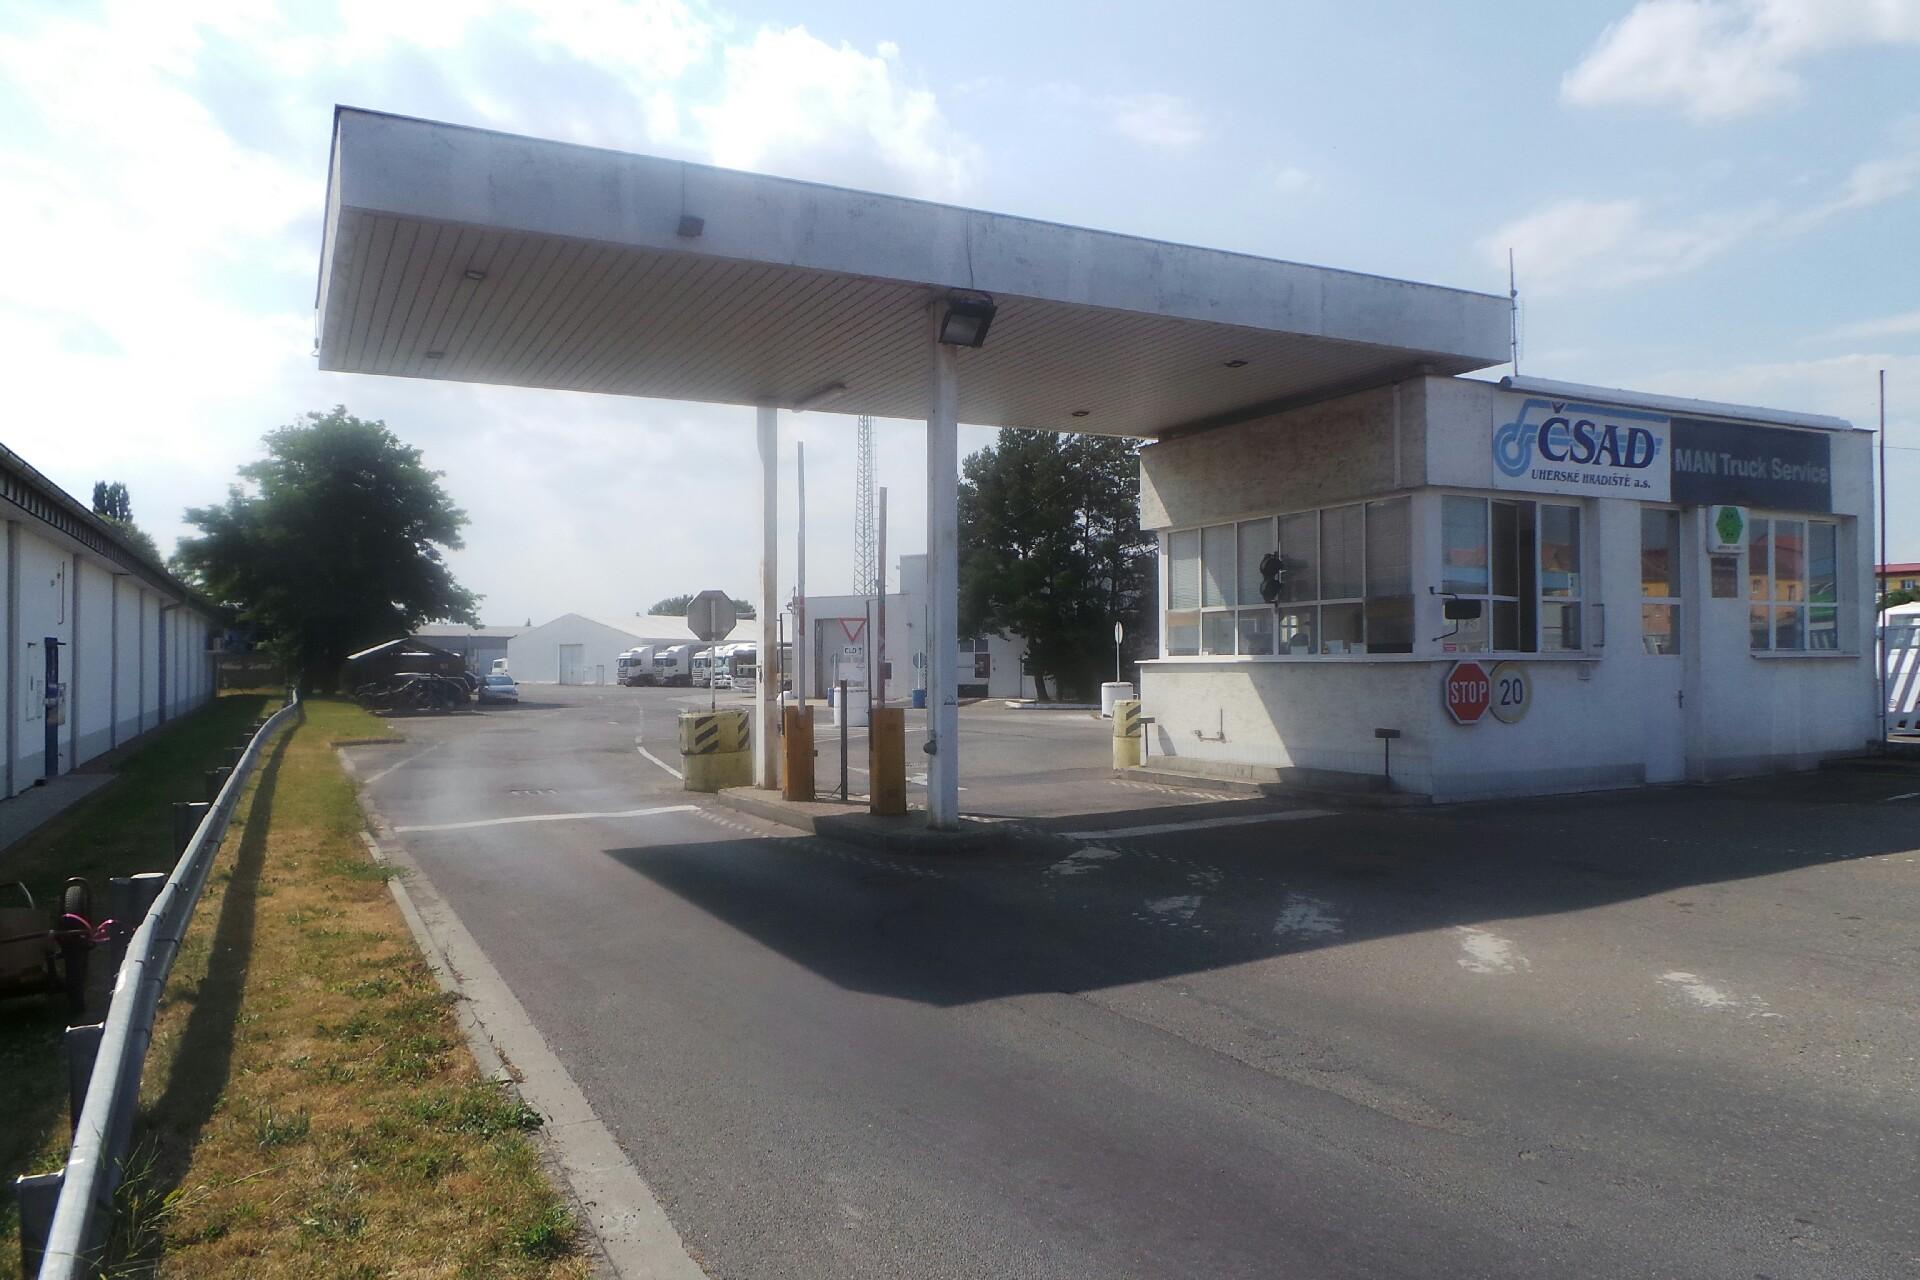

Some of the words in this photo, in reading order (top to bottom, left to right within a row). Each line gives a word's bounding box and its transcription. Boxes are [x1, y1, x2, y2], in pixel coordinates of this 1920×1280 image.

[1538, 401, 1655, 468] ČSAD
[1675, 449, 1717, 474] MAN
[1720, 453, 1768, 478] Truck
[1772, 458, 1828, 483] Service
[1634, 479, 1651, 488] a.s.
[1450, 681, 1488, 704] STOP
[1500, 678, 1523, 706] 20
